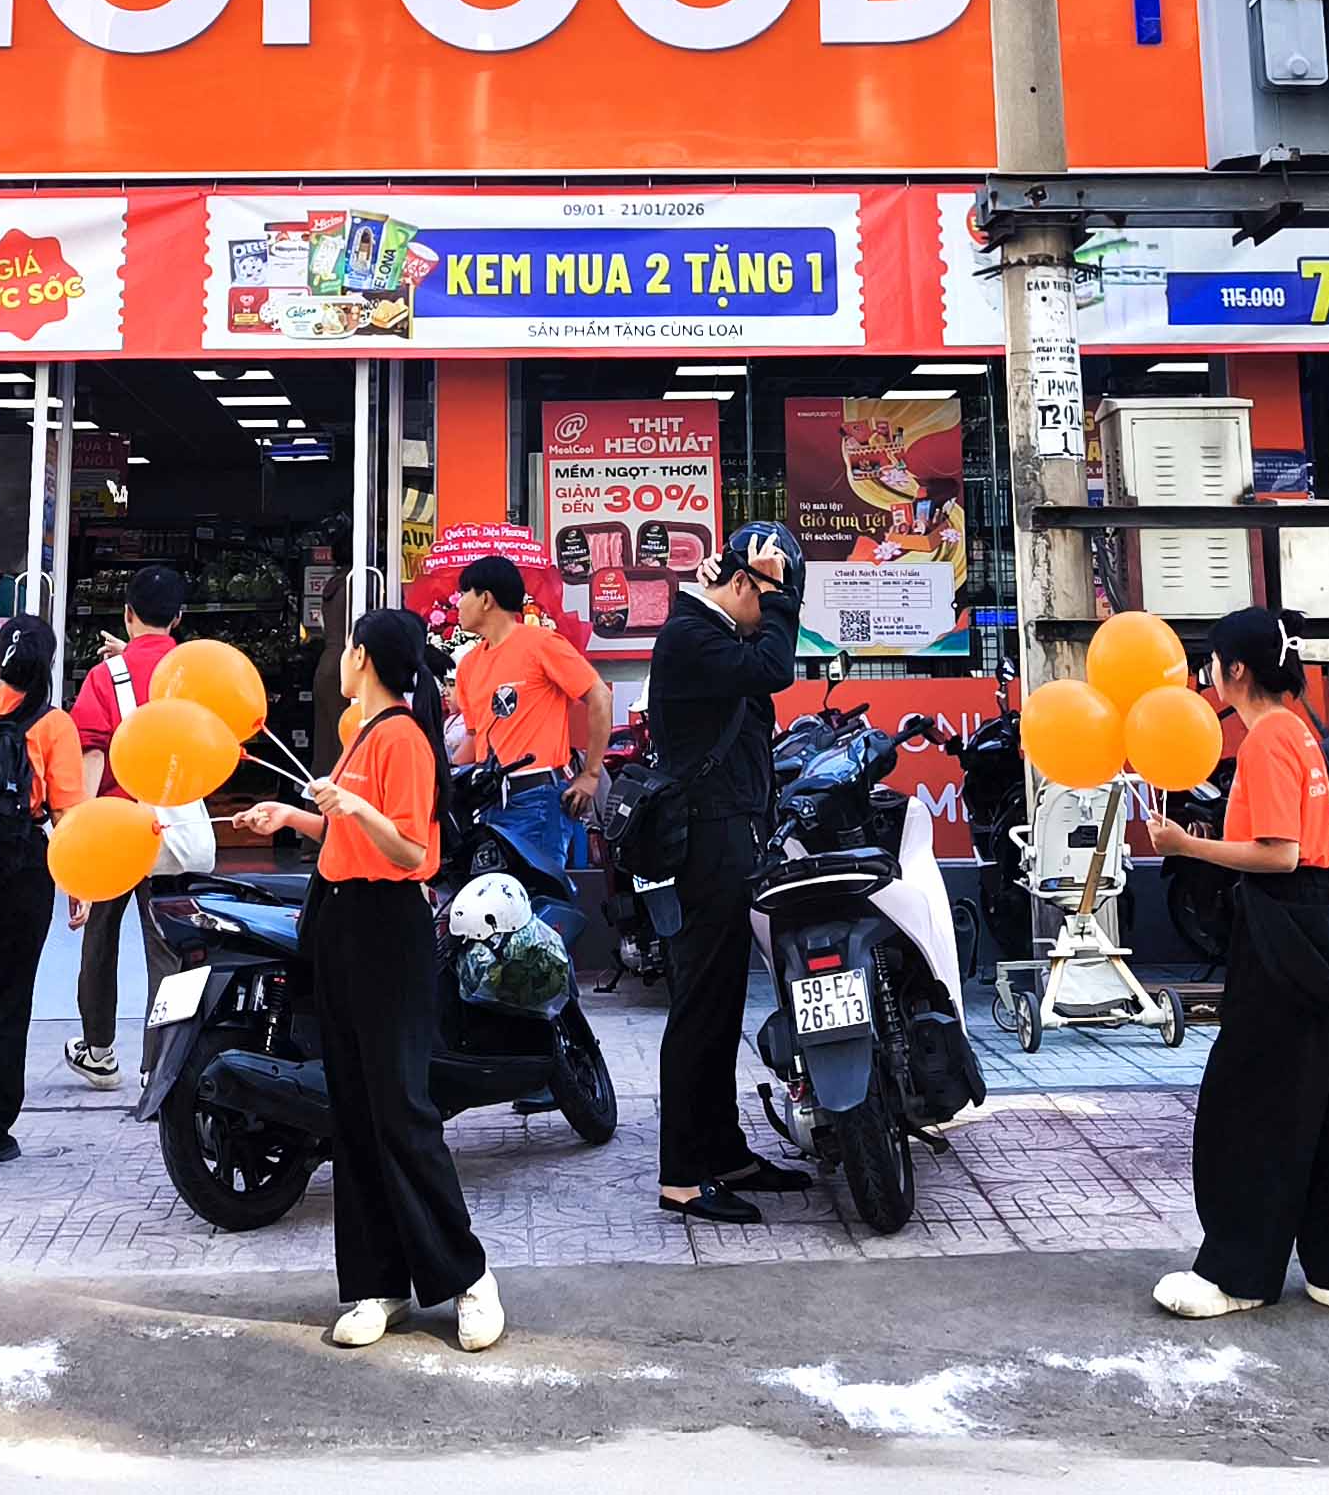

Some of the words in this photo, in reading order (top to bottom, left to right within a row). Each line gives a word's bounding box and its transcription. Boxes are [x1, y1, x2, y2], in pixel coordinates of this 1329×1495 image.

[563, 203, 604, 217] 09/01
[620, 202, 705, 217] 21/01/2026
[25, 270, 86, 305] SỐC
[446, 253, 531, 296] KEM
[545, 252, 632, 295] MUA
[645, 250, 671, 294] 2
[684, 243, 793, 309] TẶNG
[806, 251, 824, 293] 1
[528, 320, 559, 338] SẢN
[564, 318, 610, 338] PHẨM
[614, 321, 656, 342] TẶNG
[660, 319, 705, 337] CÙNG
[709, 323, 743, 342] LOẠI
[628, 417, 684, 436] THỊT
[605, 436, 657, 455] HEO
[659, 432, 713, 453] MÁT
[555, 463, 594, 478] MỀM
[605, 466, 650, 480] NGỌT
[660, 463, 707, 477] THƠM
[555, 483, 600, 499] GIẢM
[603, 484, 709, 513] 30%
[561, 499, 594, 513] ĐẾN
[799, 513, 826, 527] Giỏ
[830, 513, 861, 531] quà
[814, 532, 852, 541] selection
[801, 975, 856, 1004] 59-E2
[799, 999, 864, 1031] 265.13
